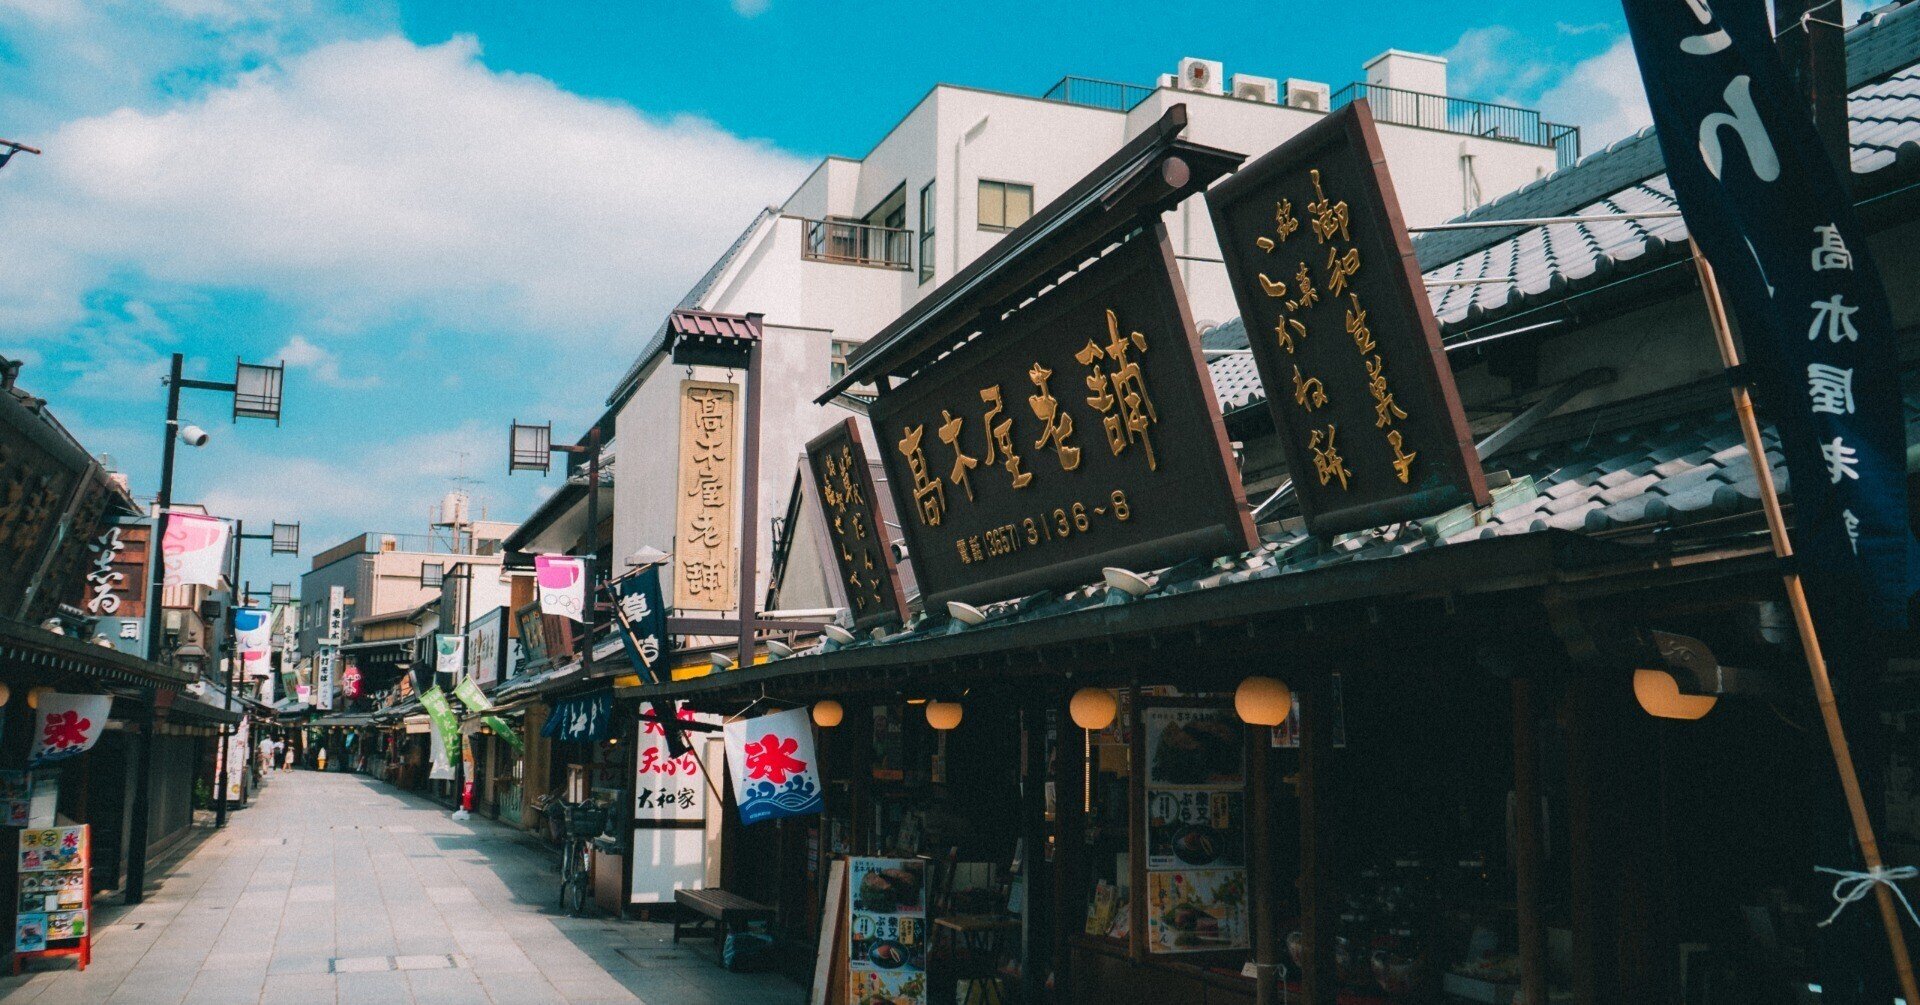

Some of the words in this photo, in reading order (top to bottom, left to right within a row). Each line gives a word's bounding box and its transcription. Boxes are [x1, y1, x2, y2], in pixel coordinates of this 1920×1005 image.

[43, 710, 91, 749] 氷
[744, 733, 808, 784] 氷
[638, 786, 696, 809] 大和家
